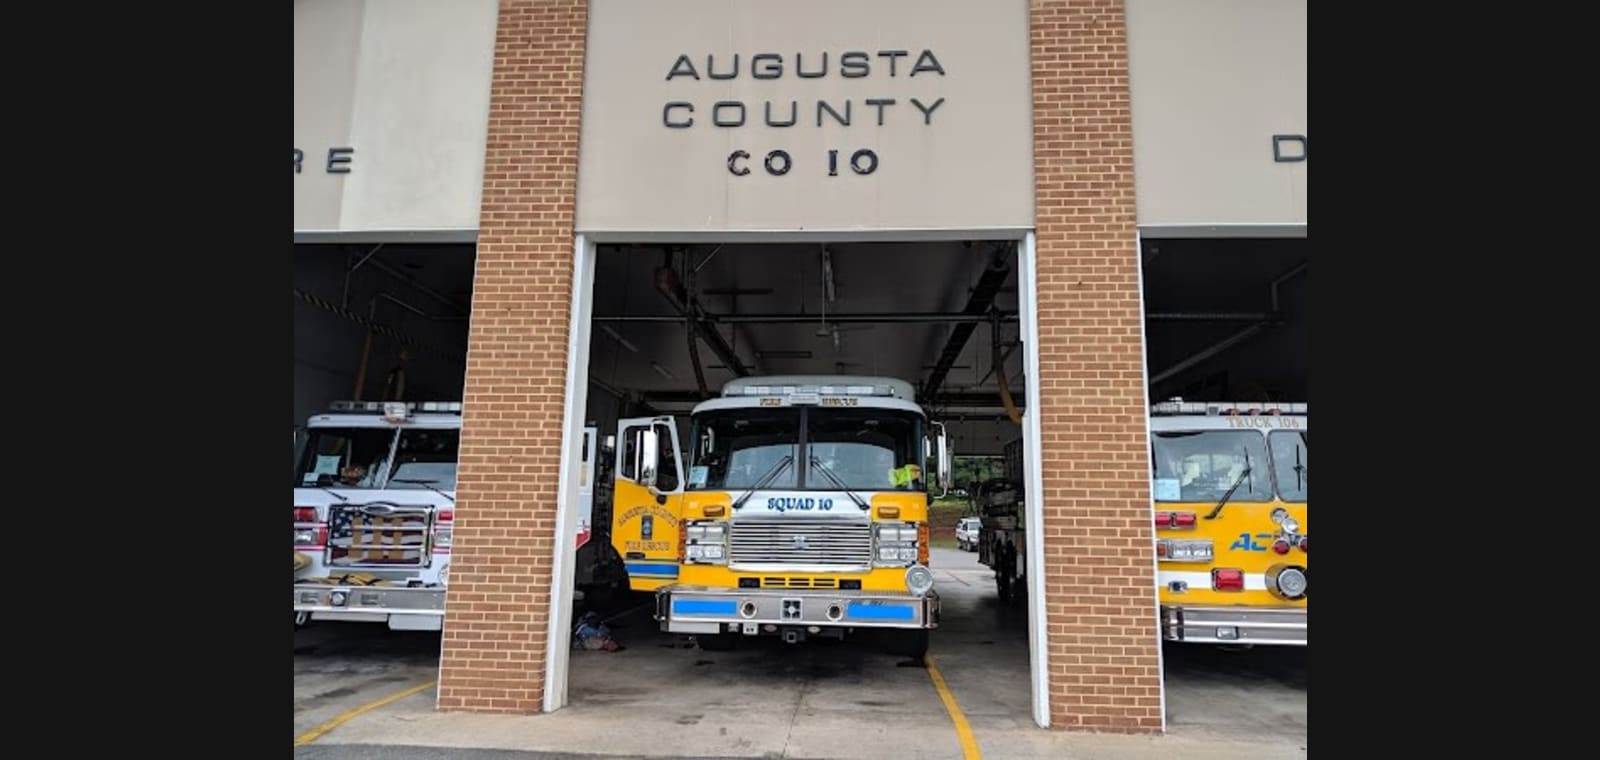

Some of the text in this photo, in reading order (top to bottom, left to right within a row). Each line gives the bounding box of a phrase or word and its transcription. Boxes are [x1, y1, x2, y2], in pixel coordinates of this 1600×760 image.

[665, 49, 946, 81] AUGUSTA
[662, 98, 945, 129] COUNTY
[727, 149, 792, 177] CO
[1226, 416, 1273, 428] TRUCK
[767, 497, 833, 512] SQUAD 10
